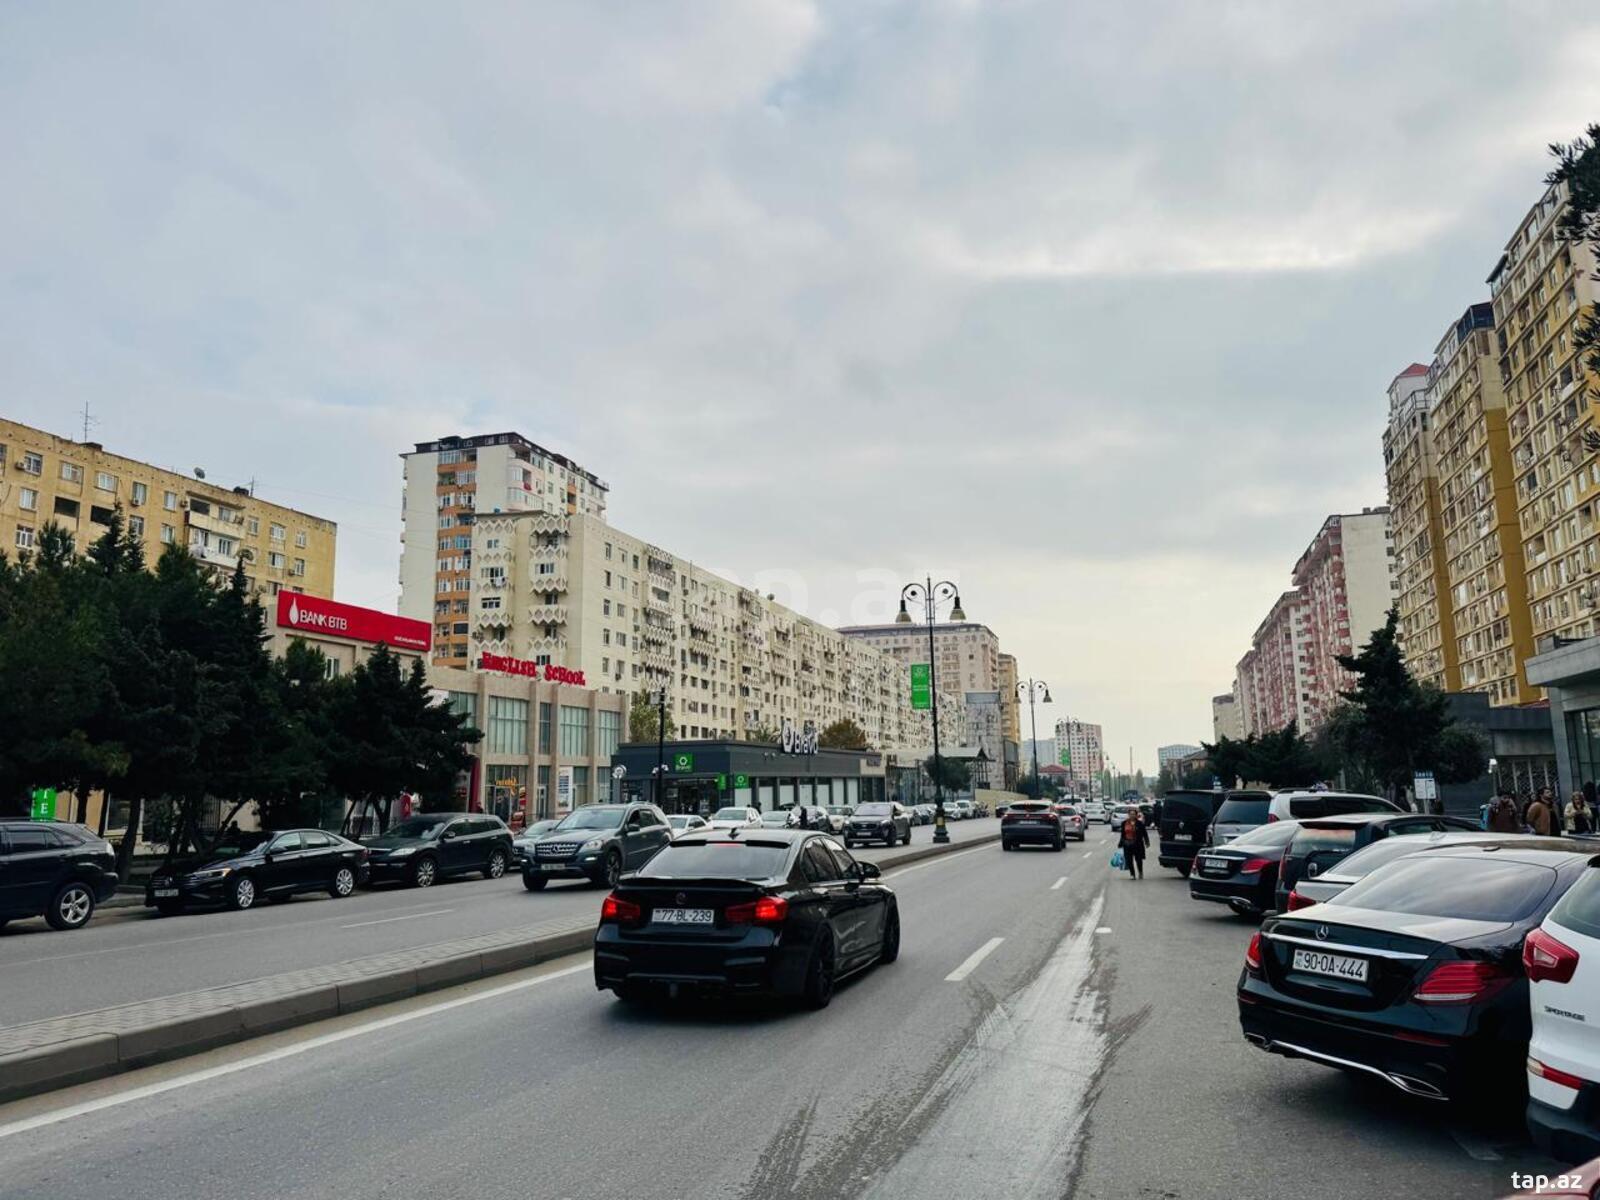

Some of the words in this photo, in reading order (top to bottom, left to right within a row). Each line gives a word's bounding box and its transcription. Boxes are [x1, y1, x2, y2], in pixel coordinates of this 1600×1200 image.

[299, 609, 328, 627] BANK
[328, 615, 347, 631] BTB
[482, 651, 537, 678] ENGLISH
